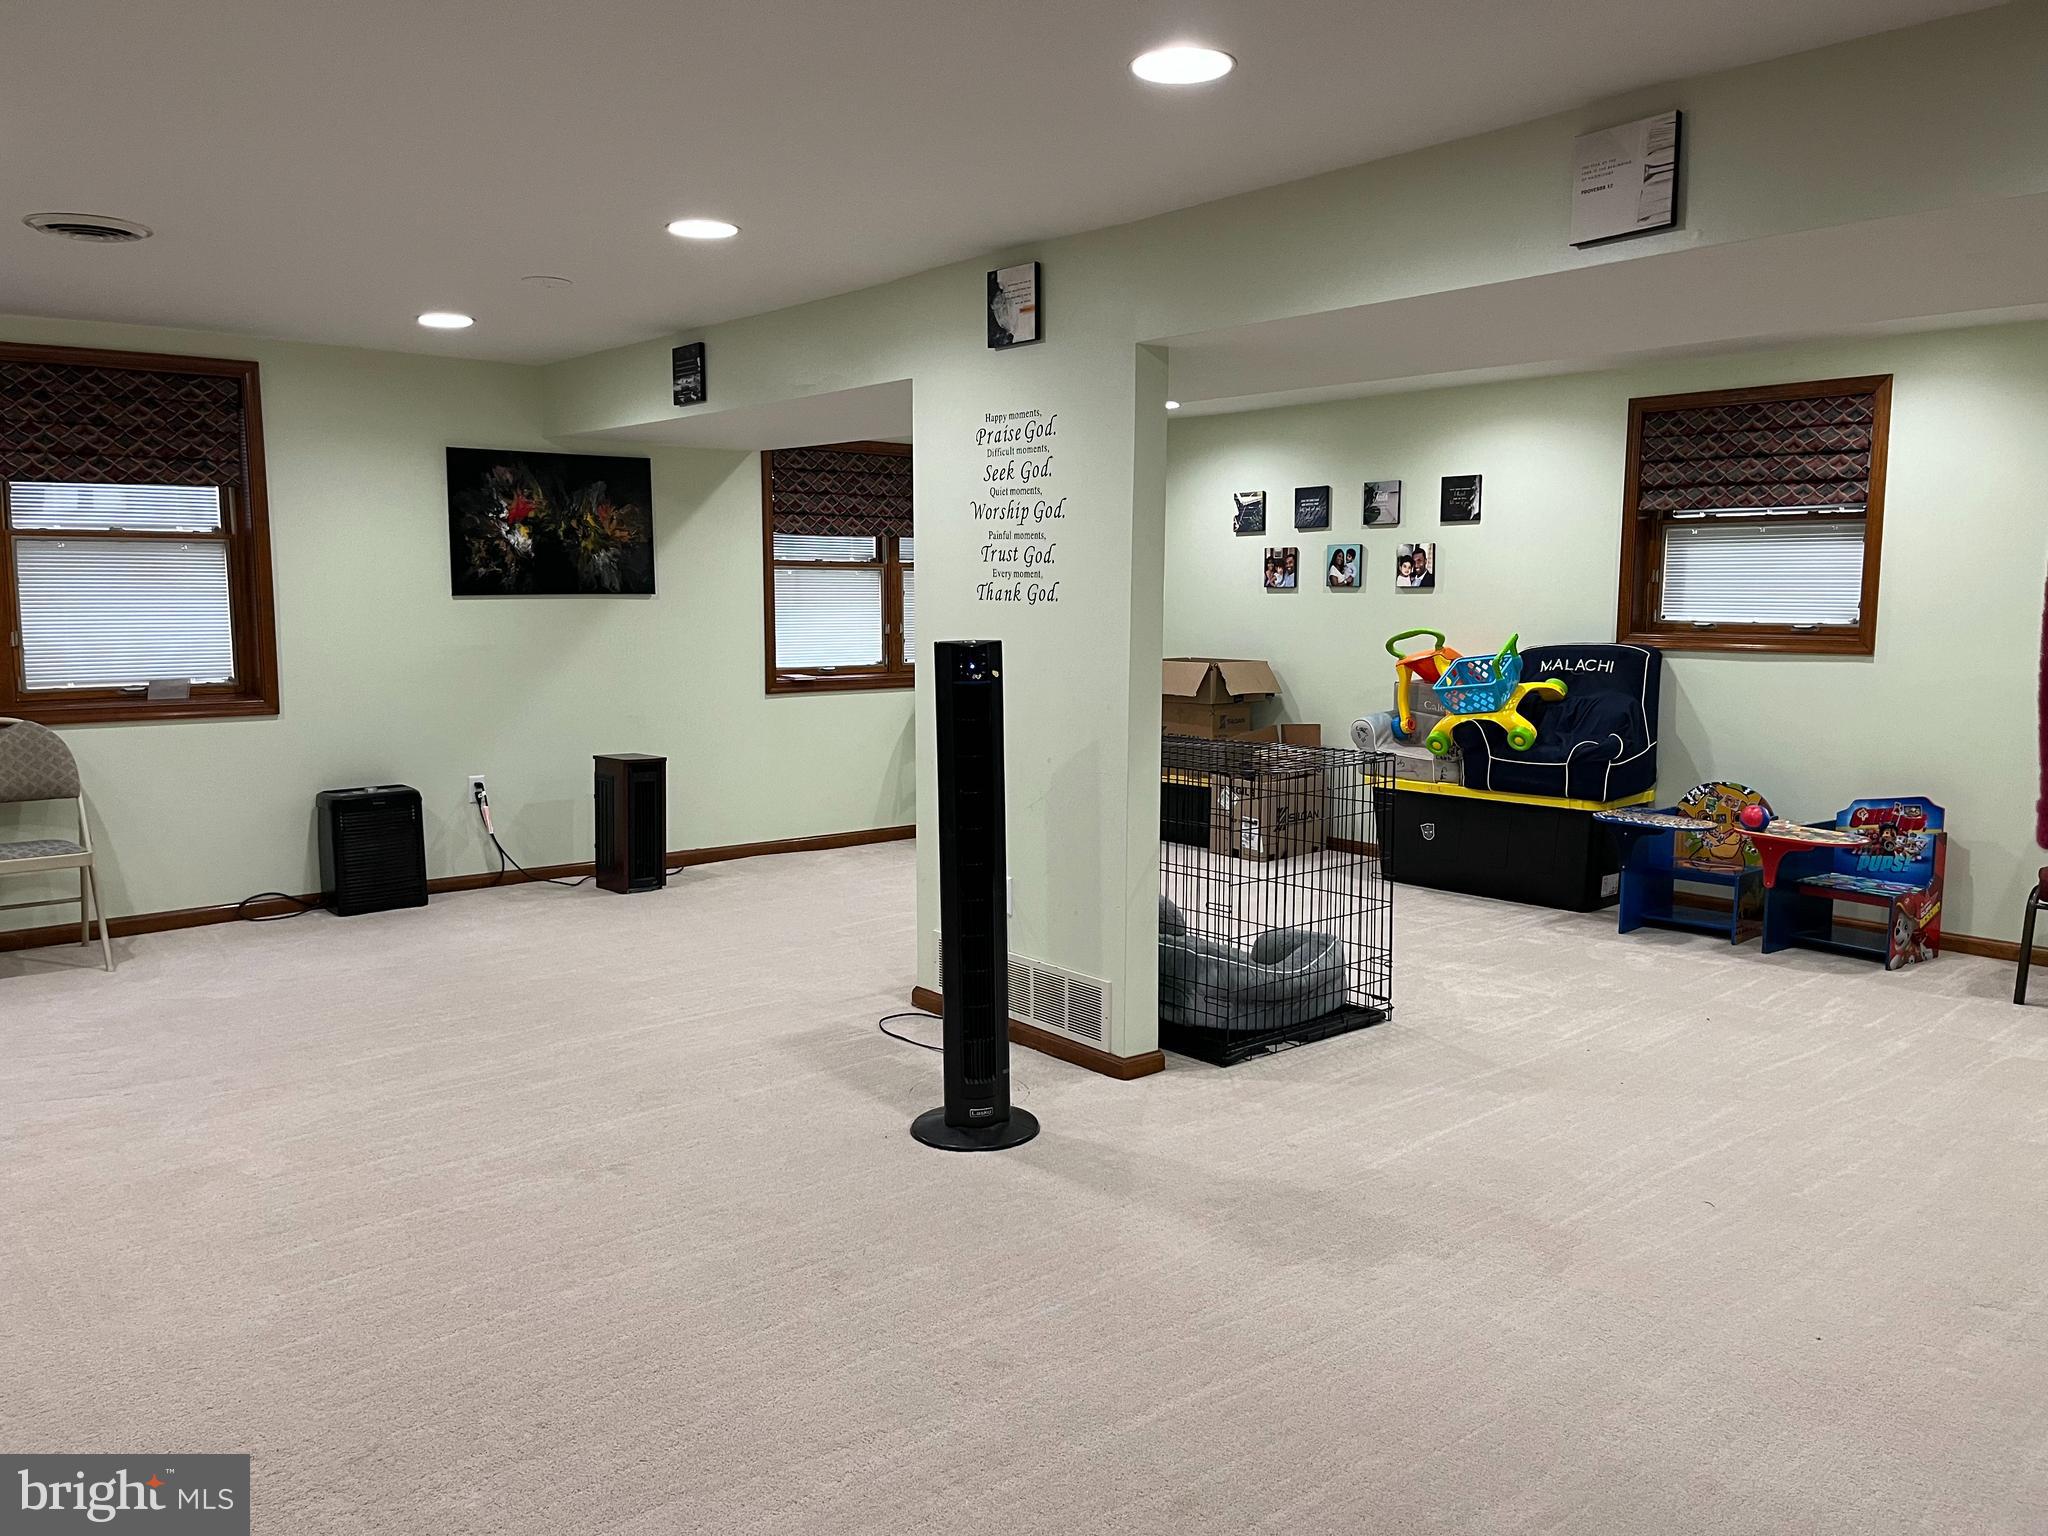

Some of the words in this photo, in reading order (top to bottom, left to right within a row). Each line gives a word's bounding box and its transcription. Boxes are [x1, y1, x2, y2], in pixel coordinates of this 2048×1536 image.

[985, 413, 1007, 424] Happy
[1009, 409, 1042, 420] moments,
[975, 424, 1021, 446] Praise
[1024, 414, 1057, 443] God.
[986, 446, 1015, 458] Difficult
[1016, 444, 1050, 455] moments,
[983, 459, 1014, 482] Seek
[1020, 456, 1053, 483] God.
[989, 487, 1009, 498] Quiet
[1009, 486, 1043, 496] moments,
[970, 499, 1029, 526] Worship
[1033, 497, 1067, 523] God.
[988, 531, 1012, 540] Painful
[1014, 531, 1046, 540] moments,
[981, 544, 1019, 563] Trust
[1023, 543, 1056, 568] God.
[992, 569, 1012, 580] Every
[1013, 570, 1043, 579] moment,
[976, 582, 1021, 602] Thank
[1027, 581, 1060, 606] God.
[1540, 658, 1614, 674] MALACHI
[1857, 853, 1912, 872] PUPS!
